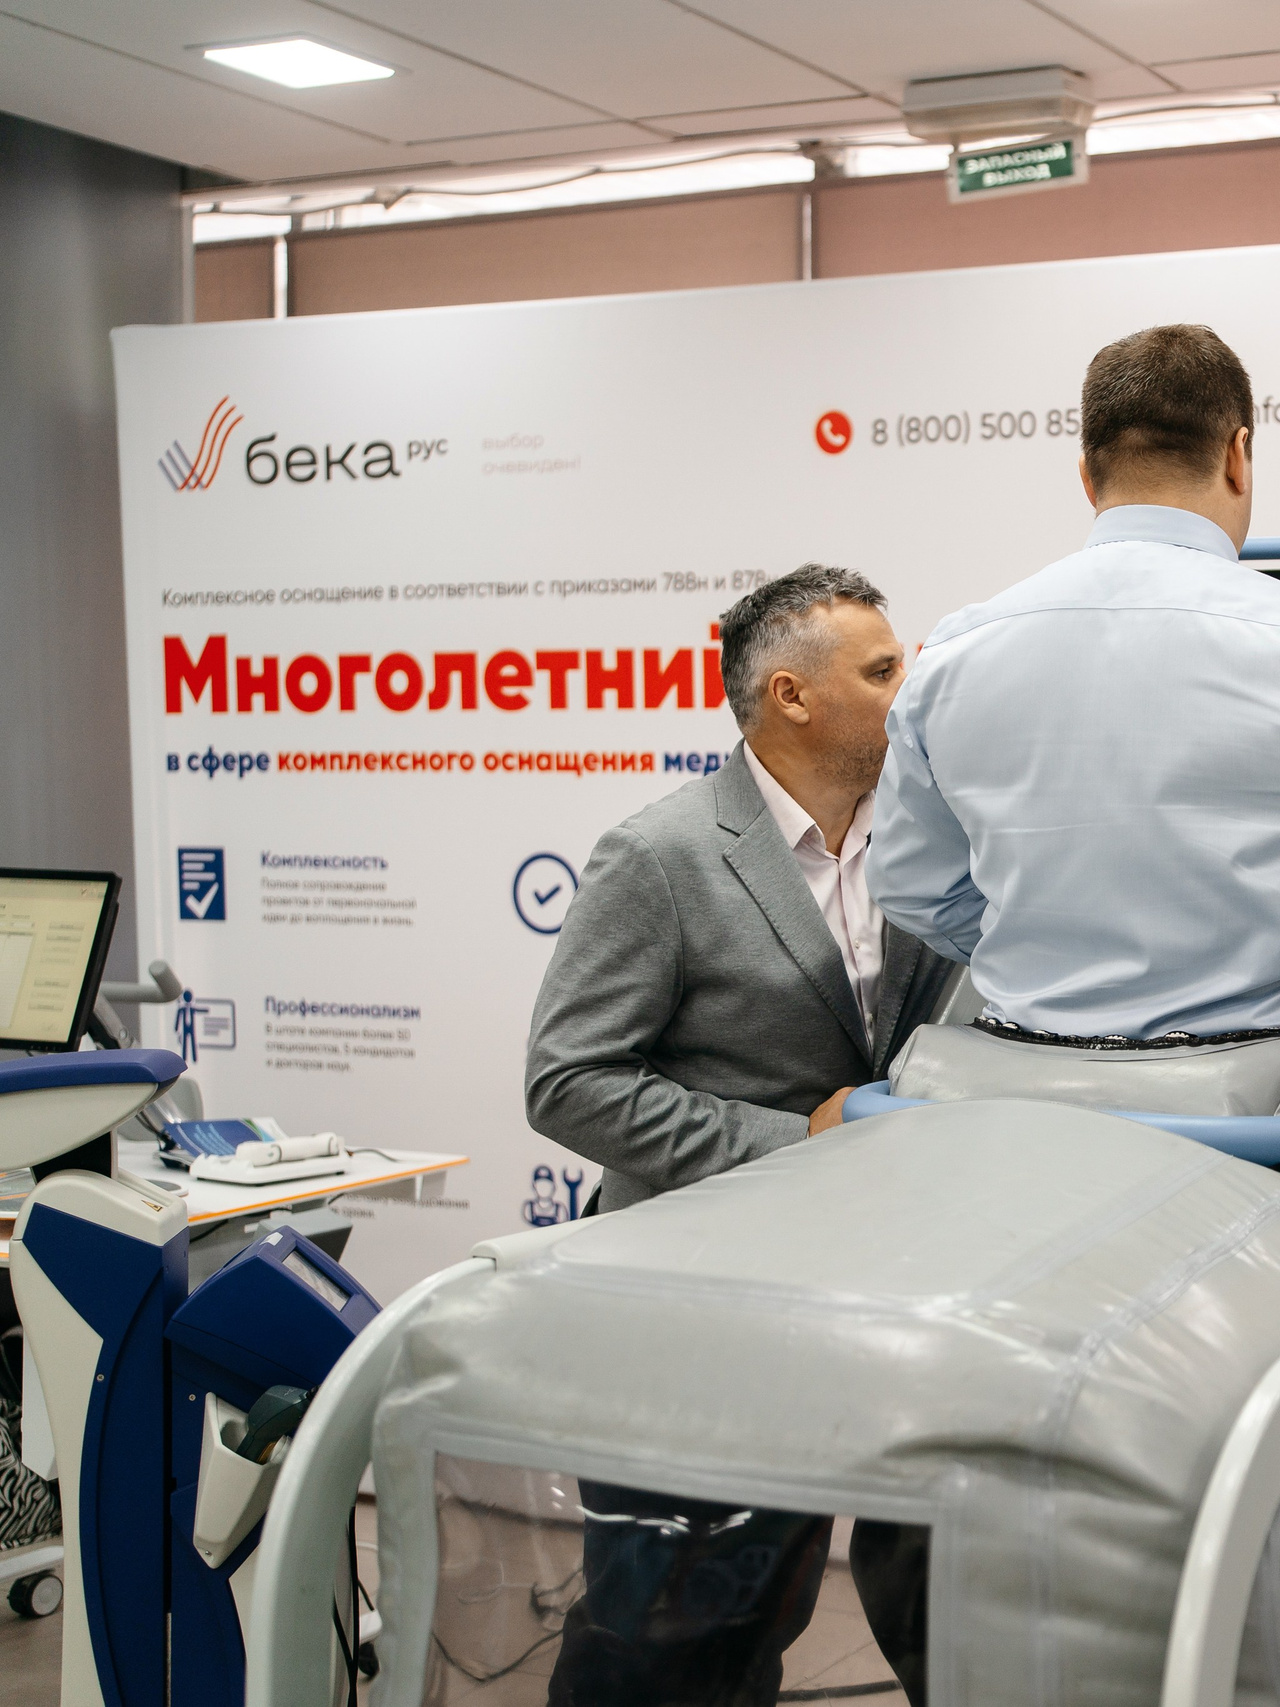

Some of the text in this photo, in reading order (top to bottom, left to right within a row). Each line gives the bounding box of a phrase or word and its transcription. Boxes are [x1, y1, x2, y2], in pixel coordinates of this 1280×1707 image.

[964, 142, 1067, 175] ЗАПАСНЫЙ
[982, 163, 1051, 187] ВЫХОД
[482, 432, 545, 452] выбор
[871, 407, 1082, 448] 8 (800) 500 85
[245, 432, 450, 486] бека рус
[162, 587, 276, 608] Комплексное
[280, 585, 384, 606] оснащение
[389, 585, 399, 601] в
[403, 580, 529, 601] соответствии
[533, 580, 546, 597] с
[550, 576, 657, 599] приказами
[662, 571, 708, 593] 788н
[714, 577, 727, 592] и
[166, 745, 730, 780] в сфере комплексного оснащения мед
[261, 850, 389, 871] Комплексность
[265, 995, 422, 1020] Профессионализм
